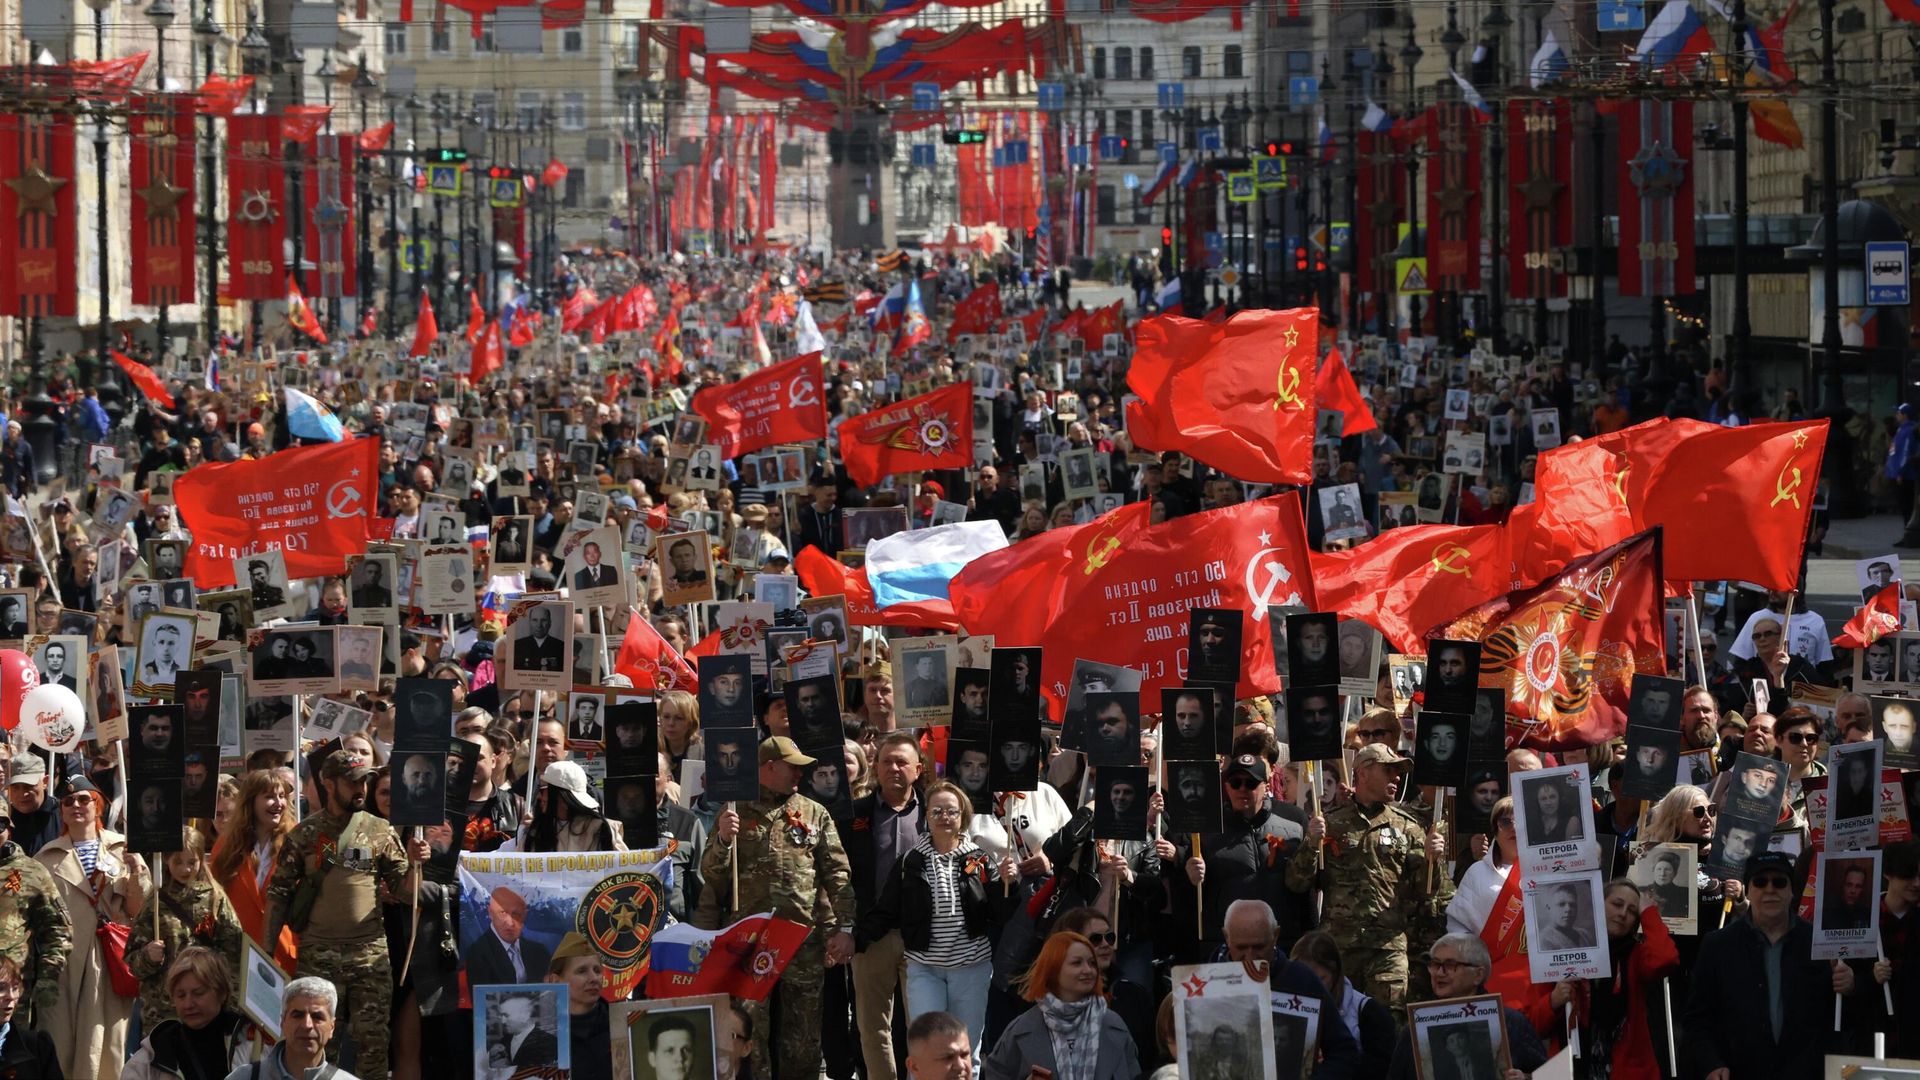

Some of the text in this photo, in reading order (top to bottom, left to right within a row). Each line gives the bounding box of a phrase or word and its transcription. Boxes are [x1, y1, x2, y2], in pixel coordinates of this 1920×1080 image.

[1523, 115, 1556, 132] 1941
[1638, 242, 1679, 261] 1945
[1523, 252, 1552, 269] 194
[241, 261, 273, 275] 1945
[1831, 817, 1875, 831] ПАРФЕНТЬЕВА
[1539, 843, 1578, 856] ПЕТРОВА
[462, 856, 492, 874] ТАМ
[494, 857, 523, 876] ГДЕ
[525, 857, 544, 874] НЕ
[546, 853, 616, 874] ПРОЙДУТ
[595, 879, 615, 894] ЧВК
[1553, 952, 1587, 962] ПЕТРОВ
[1301, 1005, 1320, 1014] ПОЛК
[1477, 1008, 1498, 1016] ПОЛК
